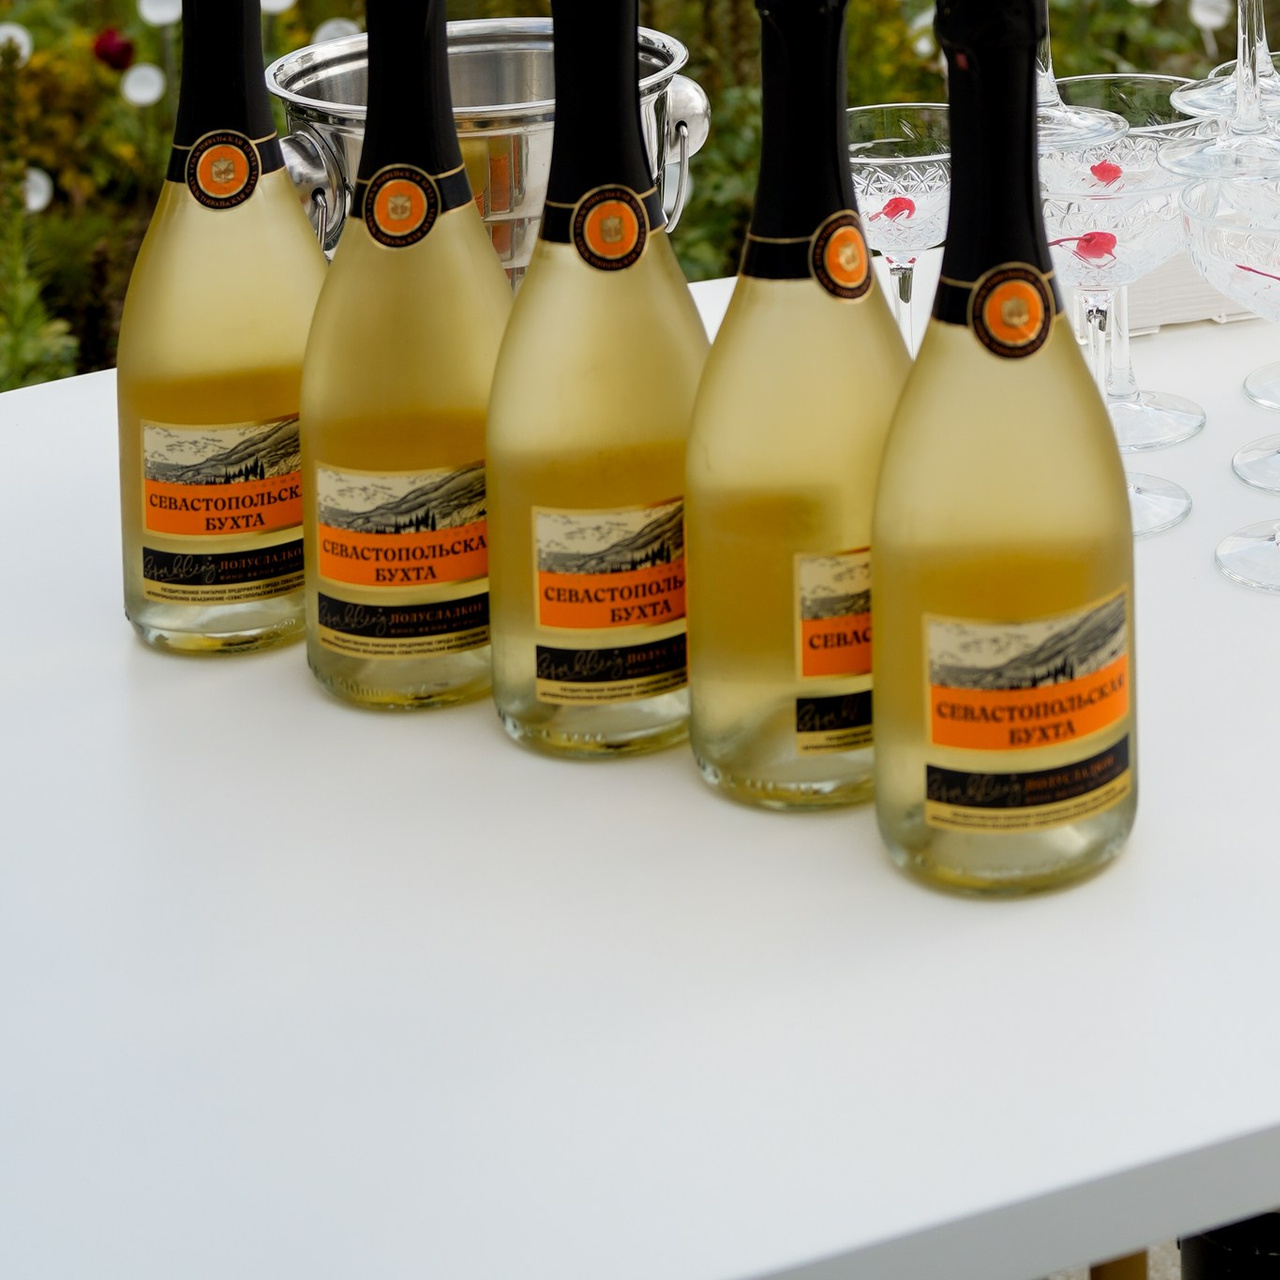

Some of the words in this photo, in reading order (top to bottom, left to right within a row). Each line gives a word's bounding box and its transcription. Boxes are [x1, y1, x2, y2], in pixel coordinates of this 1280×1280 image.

[150, 485, 302, 512] СЕВАСТОПОЛЬСК
[205, 513, 265, 531] БУХТА
[323, 535, 487, 562] СЕВАСТОПОЛЬСКА
[375, 566, 437, 582] БУХТА
[610, 599, 672, 623] БУХТА
[936, 673, 1124, 724] СЕВАСТОПОЛЬСКАЯ
[1009, 720, 1075, 746] БУХТА
